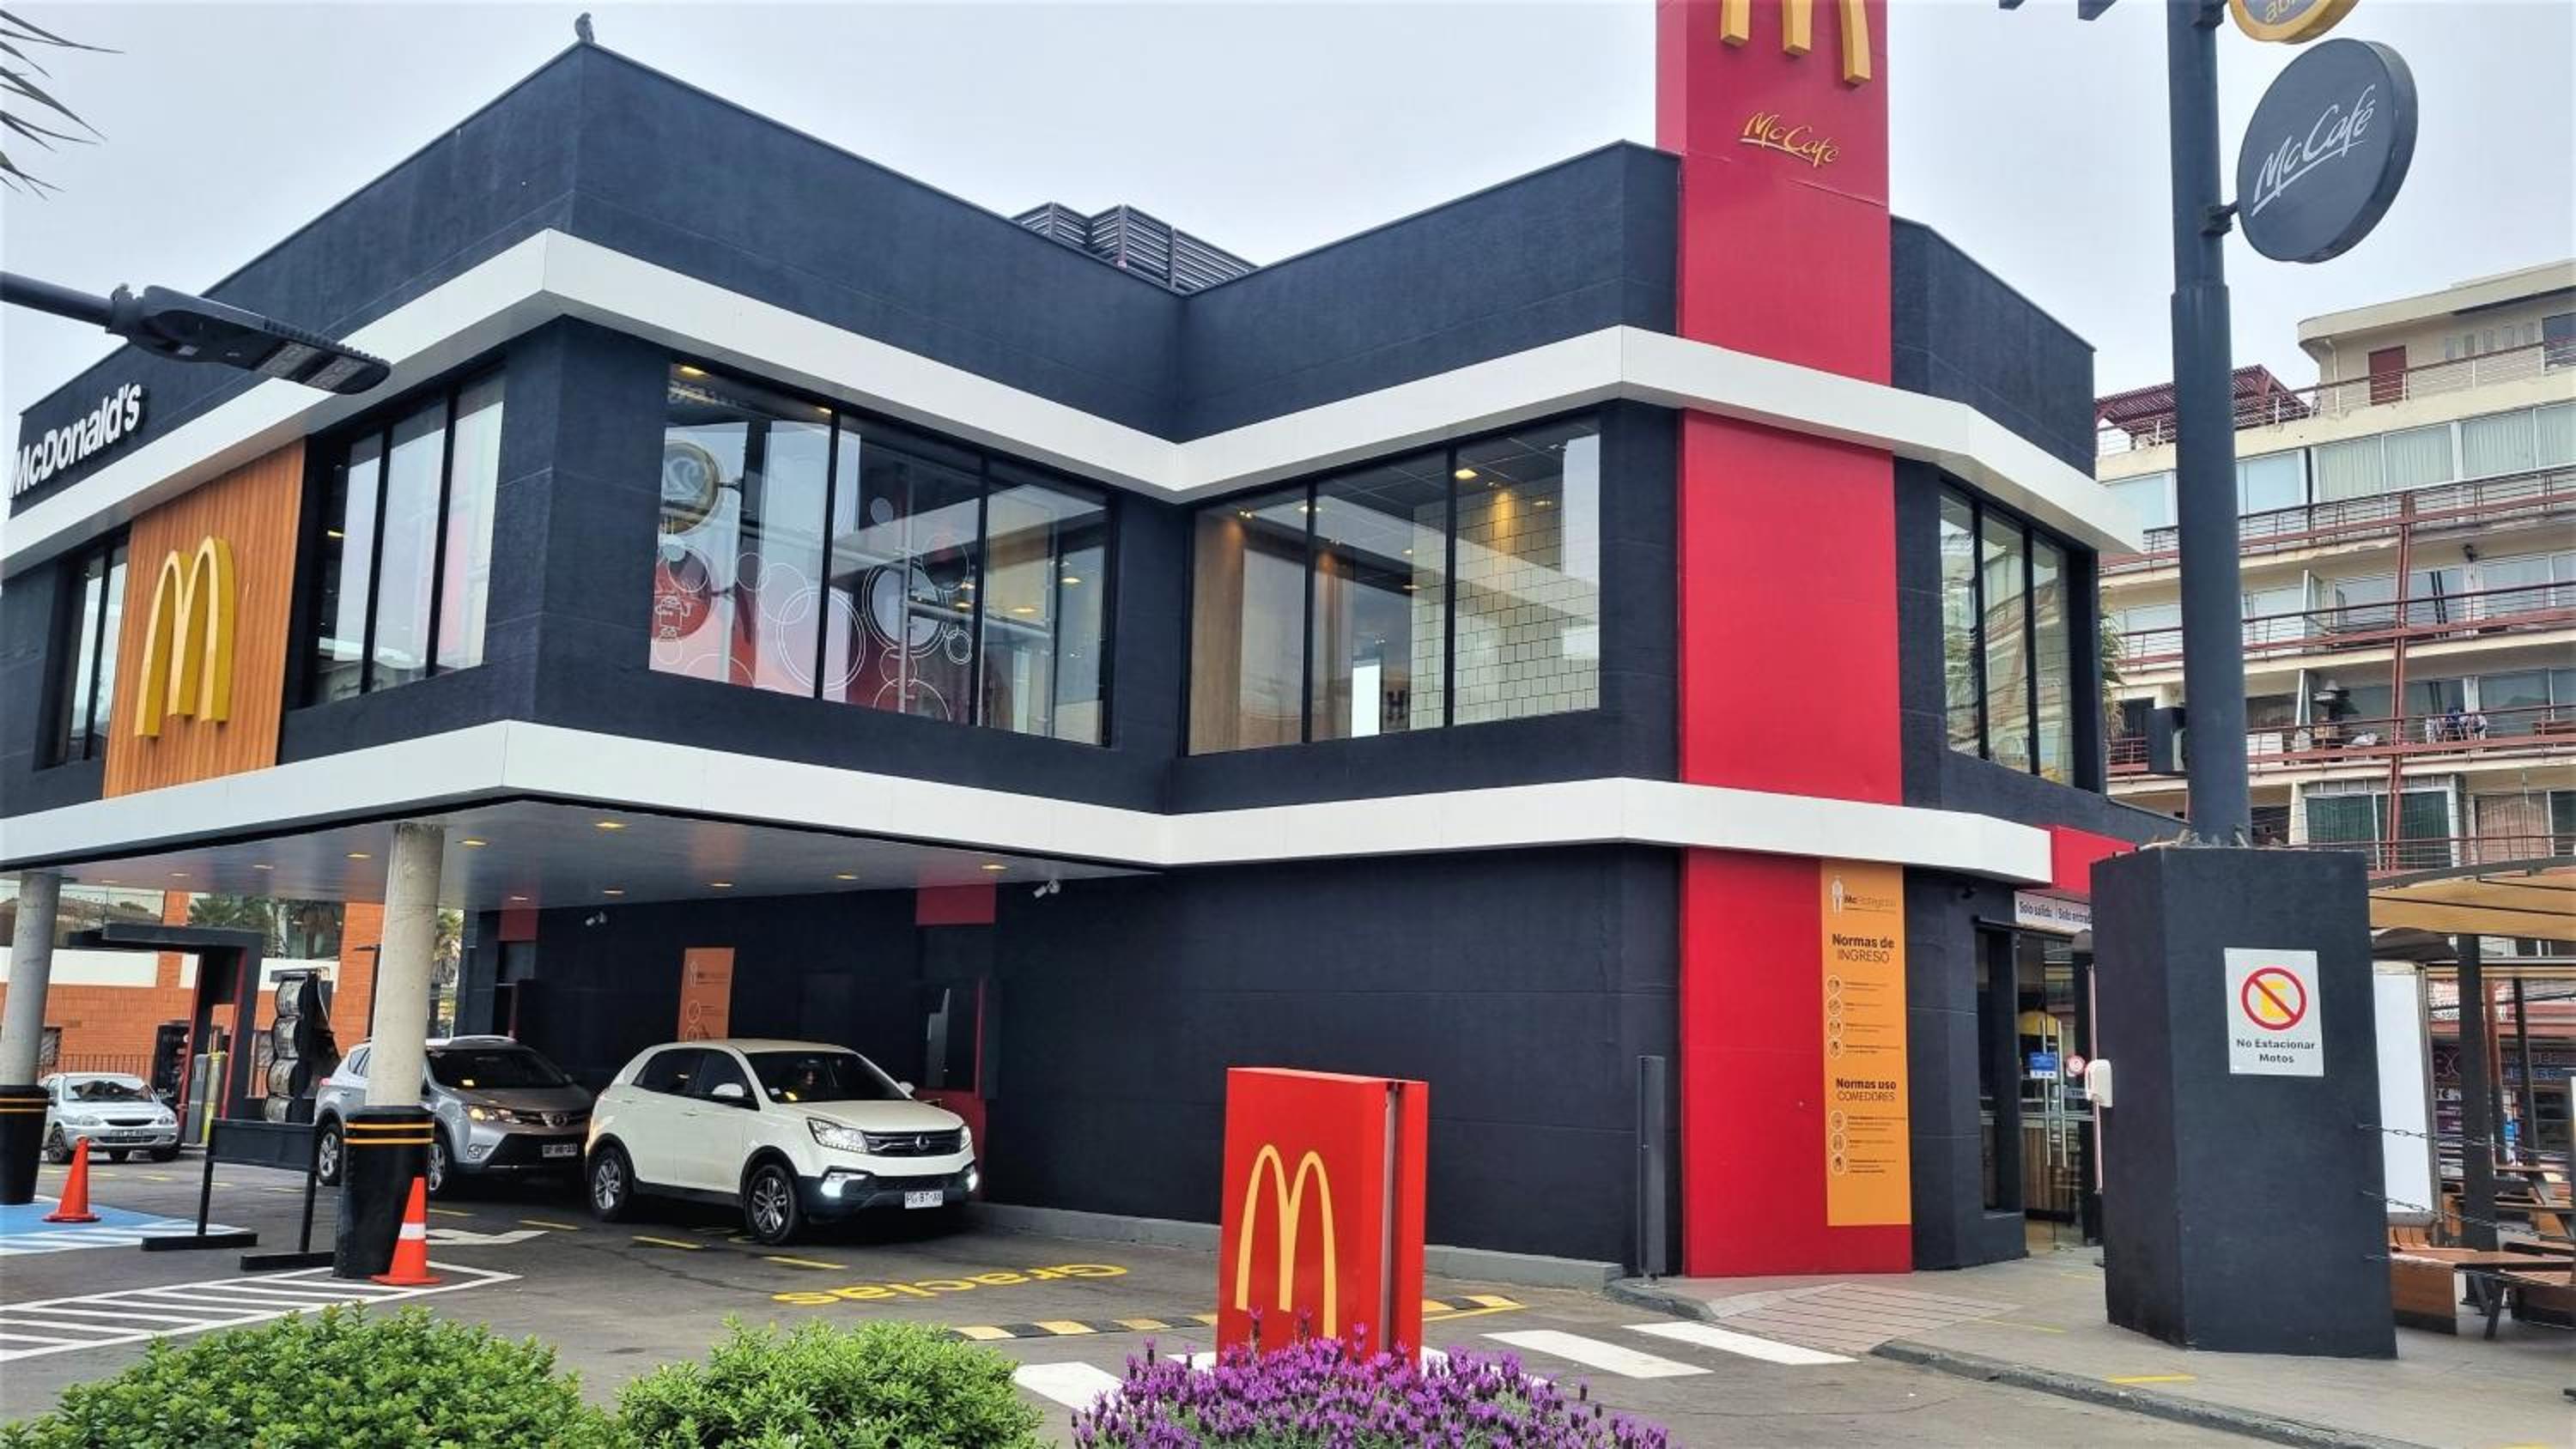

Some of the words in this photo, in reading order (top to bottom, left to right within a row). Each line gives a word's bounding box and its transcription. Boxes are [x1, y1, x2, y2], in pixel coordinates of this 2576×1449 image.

[2250, 83, 2377, 216] McCafé
[9, 383, 143, 499] McDonald's
[1832, 933, 1878, 949] Normas
[1880, 937, 1895, 949] de
[1838, 948, 1891, 963] INGRESO
[2236, 1038, 2252, 1048] No
[2254, 1038, 2316, 1050] Estacionar
[2258, 1053, 2295, 1064] Motos
[1836, 1077, 1876, 1090] Normas
[1878, 1080, 1897, 1090] uso
[1838, 1089, 1896, 1102] COMEDORES
[770, 1264, 1128, 1306] Gracias
